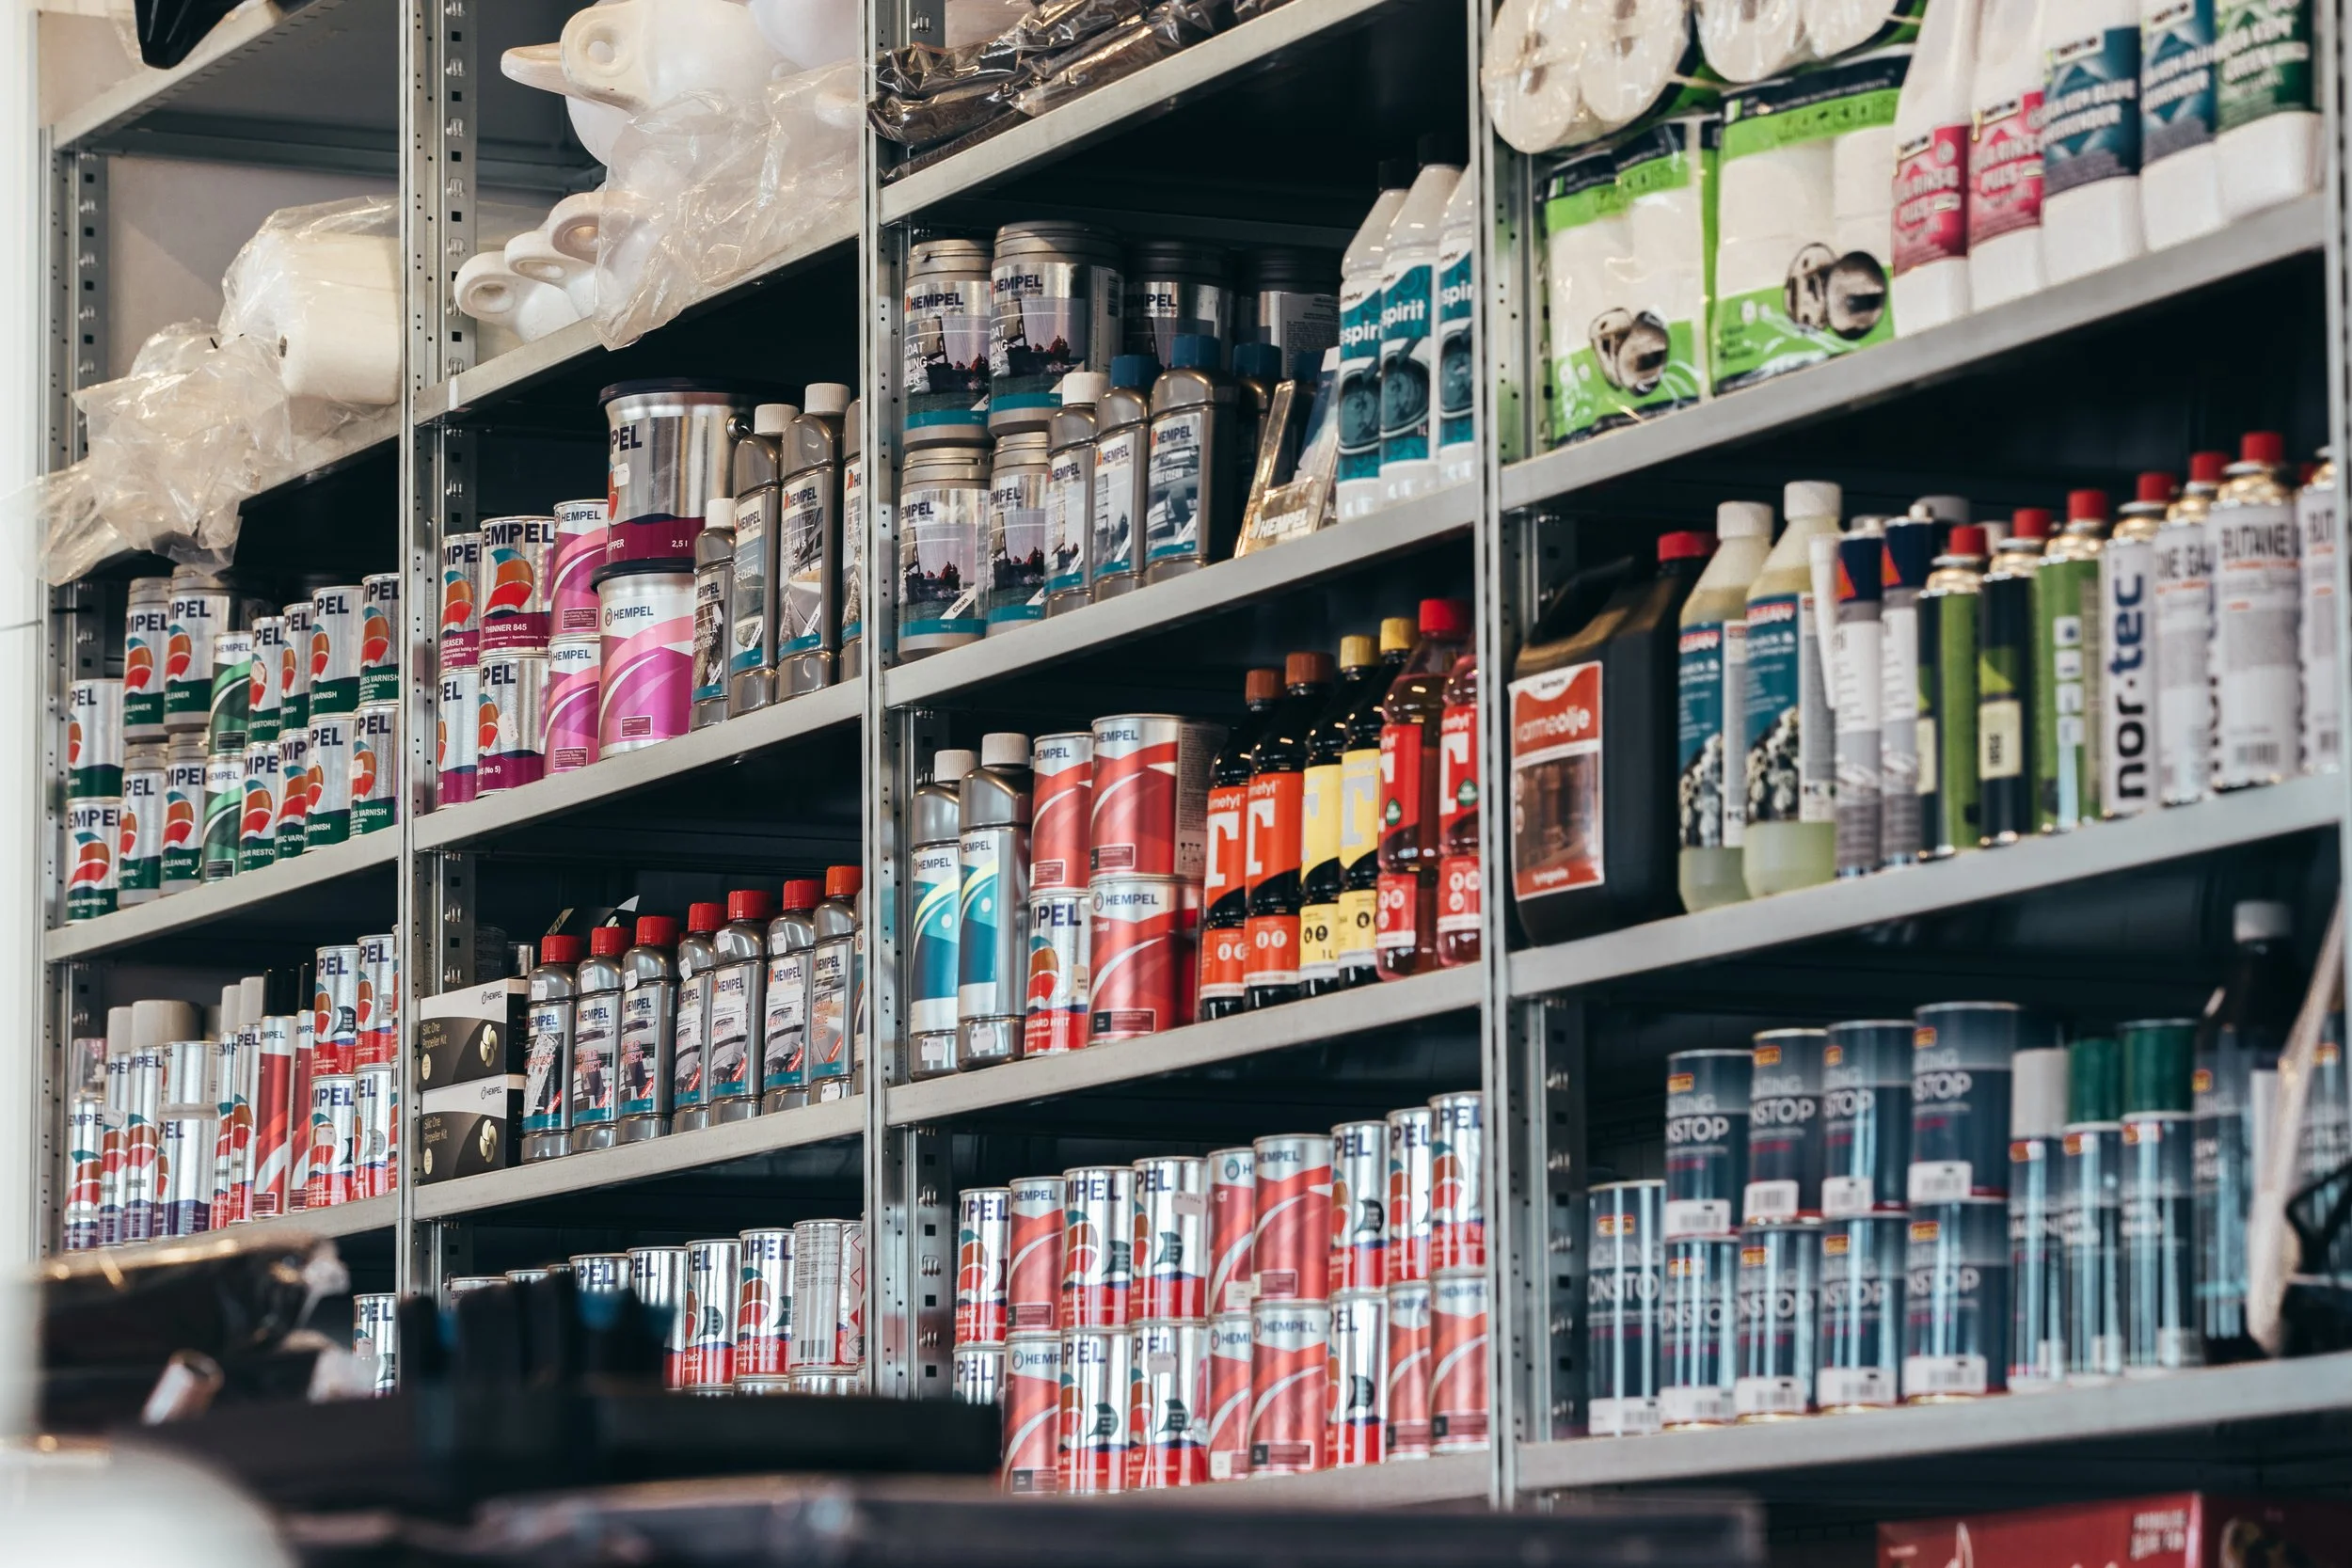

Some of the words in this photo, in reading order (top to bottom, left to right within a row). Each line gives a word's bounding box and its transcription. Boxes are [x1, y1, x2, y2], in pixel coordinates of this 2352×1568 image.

[994, 275, 1043, 293] HEMPEL
[911, 293, 963, 310] HEMPEL
[1382, 299, 1425, 327] spirit
[1158, 425, 1192, 444] HEMPEL
[1103, 445, 1129, 465] HEMPEL
[1051, 462, 1080, 481] HEMPEL
[788, 486, 817, 506] HEMPEL
[562, 511, 600, 522] HEMPEL
[739, 512, 760, 532] HEMPEL
[802, 537, 806, 546] &
[314, 595, 349, 616] PEL
[952, 597, 968, 613] Clean
[613, 607, 654, 620] HEMPEL
[485, 624, 512, 634] THINNER
[513, 623, 527, 631] 845
[553, 650, 591, 660] HEMPEL
[480, 665, 516, 688] PEL
[310, 727, 343, 748] PEL
[1096, 730, 1138, 743] HEMPEL
[485, 766, 493, 775] (No
[495, 766, 501, 775] 5)
[69, 810, 120, 829] EMPE
[359, 808, 387, 816] VARNISH
[962, 840, 992, 852] EMPEL
[918, 857, 951, 870] HEMPEL
[1105, 894, 1159, 906] HEMPEL
[816, 956, 840, 971] HEMPEL
[775, 966, 802, 983] HEMPEL
[717, 977, 743, 993] HEMPEL
[486, 991, 502, 1001] HEMPEL
[580, 1007, 609, 1022] HEMPEL
[432, 1022, 440, 1033] One
[486, 1086, 502, 1095] HEMPEL
[1913, 1071, 1972, 1101] STOP
[1256, 1150, 1300, 1164] HEMPEL
[1013, 1190, 1057, 1202] HEMPEL
[1263, 1320, 1316, 1334] HEMPEL
